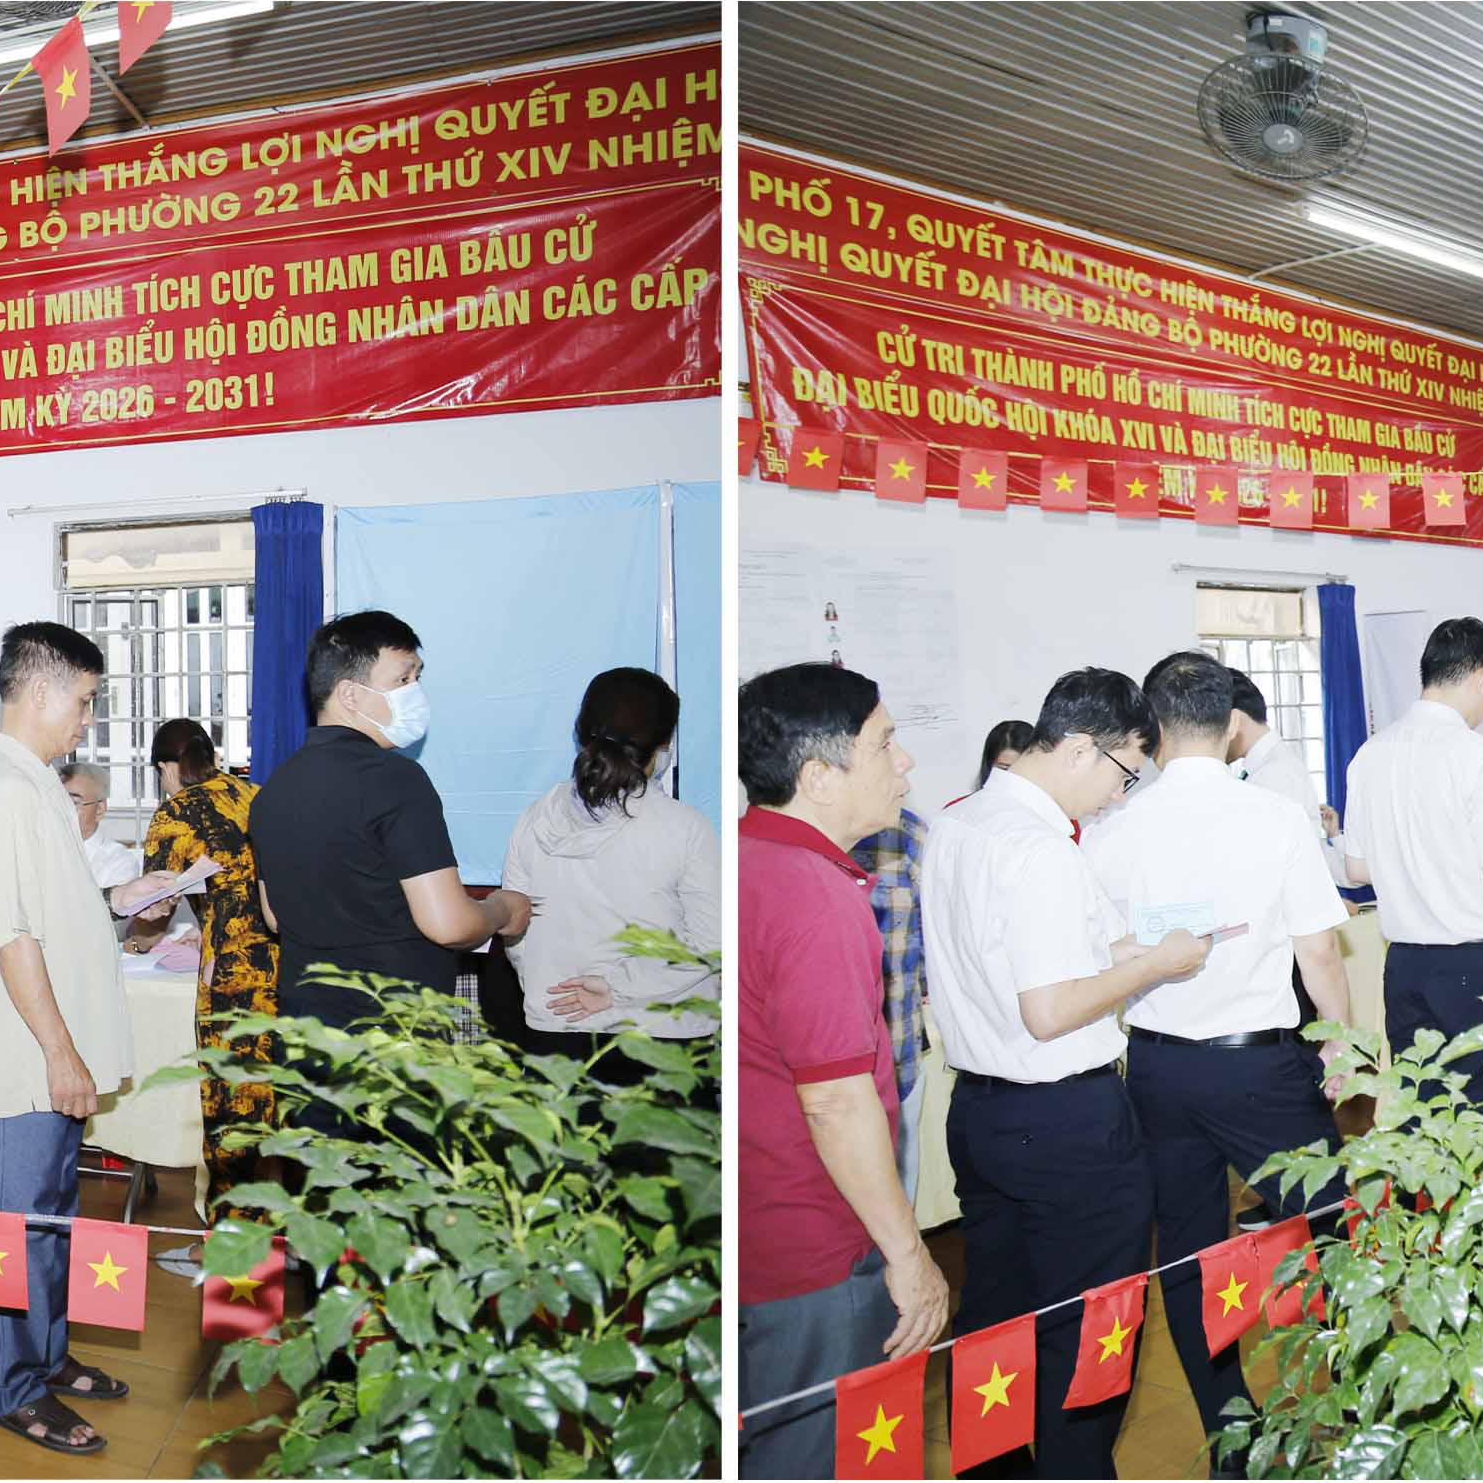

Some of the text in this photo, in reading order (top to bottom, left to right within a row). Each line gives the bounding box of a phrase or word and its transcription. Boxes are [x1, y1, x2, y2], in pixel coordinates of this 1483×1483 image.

[241, 136, 302, 175] LỢI
[316, 115, 420, 163] NGHỊ
[435, 81, 572, 140] QUYẾT
[585, 74, 667, 124] ĐẠI
[253, 142, 573, 217] 22 LẦN THỨ XIV
[131, 211, 599, 316] TÍCH CỰC THAM GIA BẦU CỬ
[748, 170, 833, 218] PHỐ
[843, 195, 897, 240] 17,
[906, 212, 1007, 263] QUYẾT
[1013, 239, 1075, 281] TÂM
[34, 382, 73, 429] KỲ
[81, 382, 157, 422] 2026
[184, 371, 276, 415] 2031!
[876, 324, 1054, 392] CỬ TRI THÀNH
